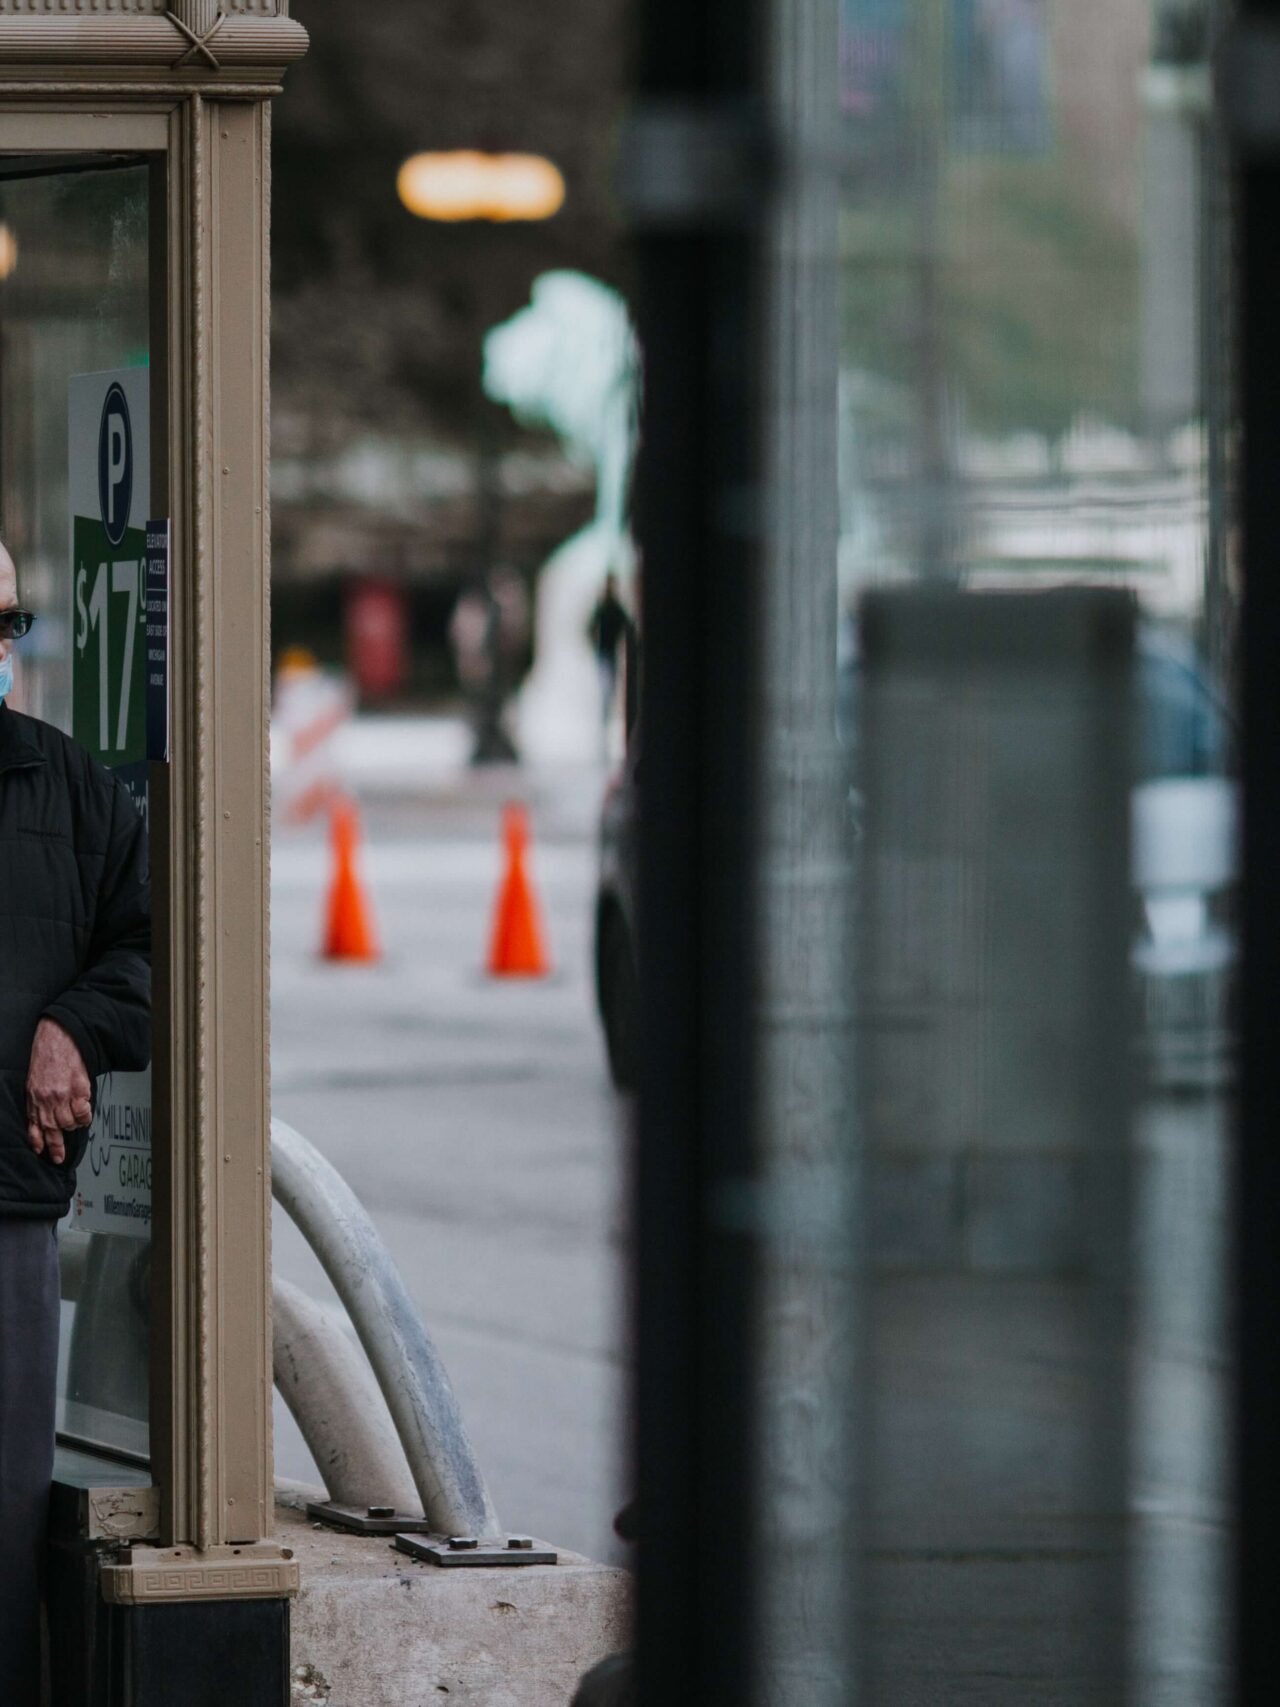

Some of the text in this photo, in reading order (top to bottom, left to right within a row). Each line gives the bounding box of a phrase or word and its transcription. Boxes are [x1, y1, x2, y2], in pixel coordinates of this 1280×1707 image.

[108, 413, 126, 523] P
[148, 560, 166, 575] ACCESS
[102, 1104, 152, 1143] MILLENNI
